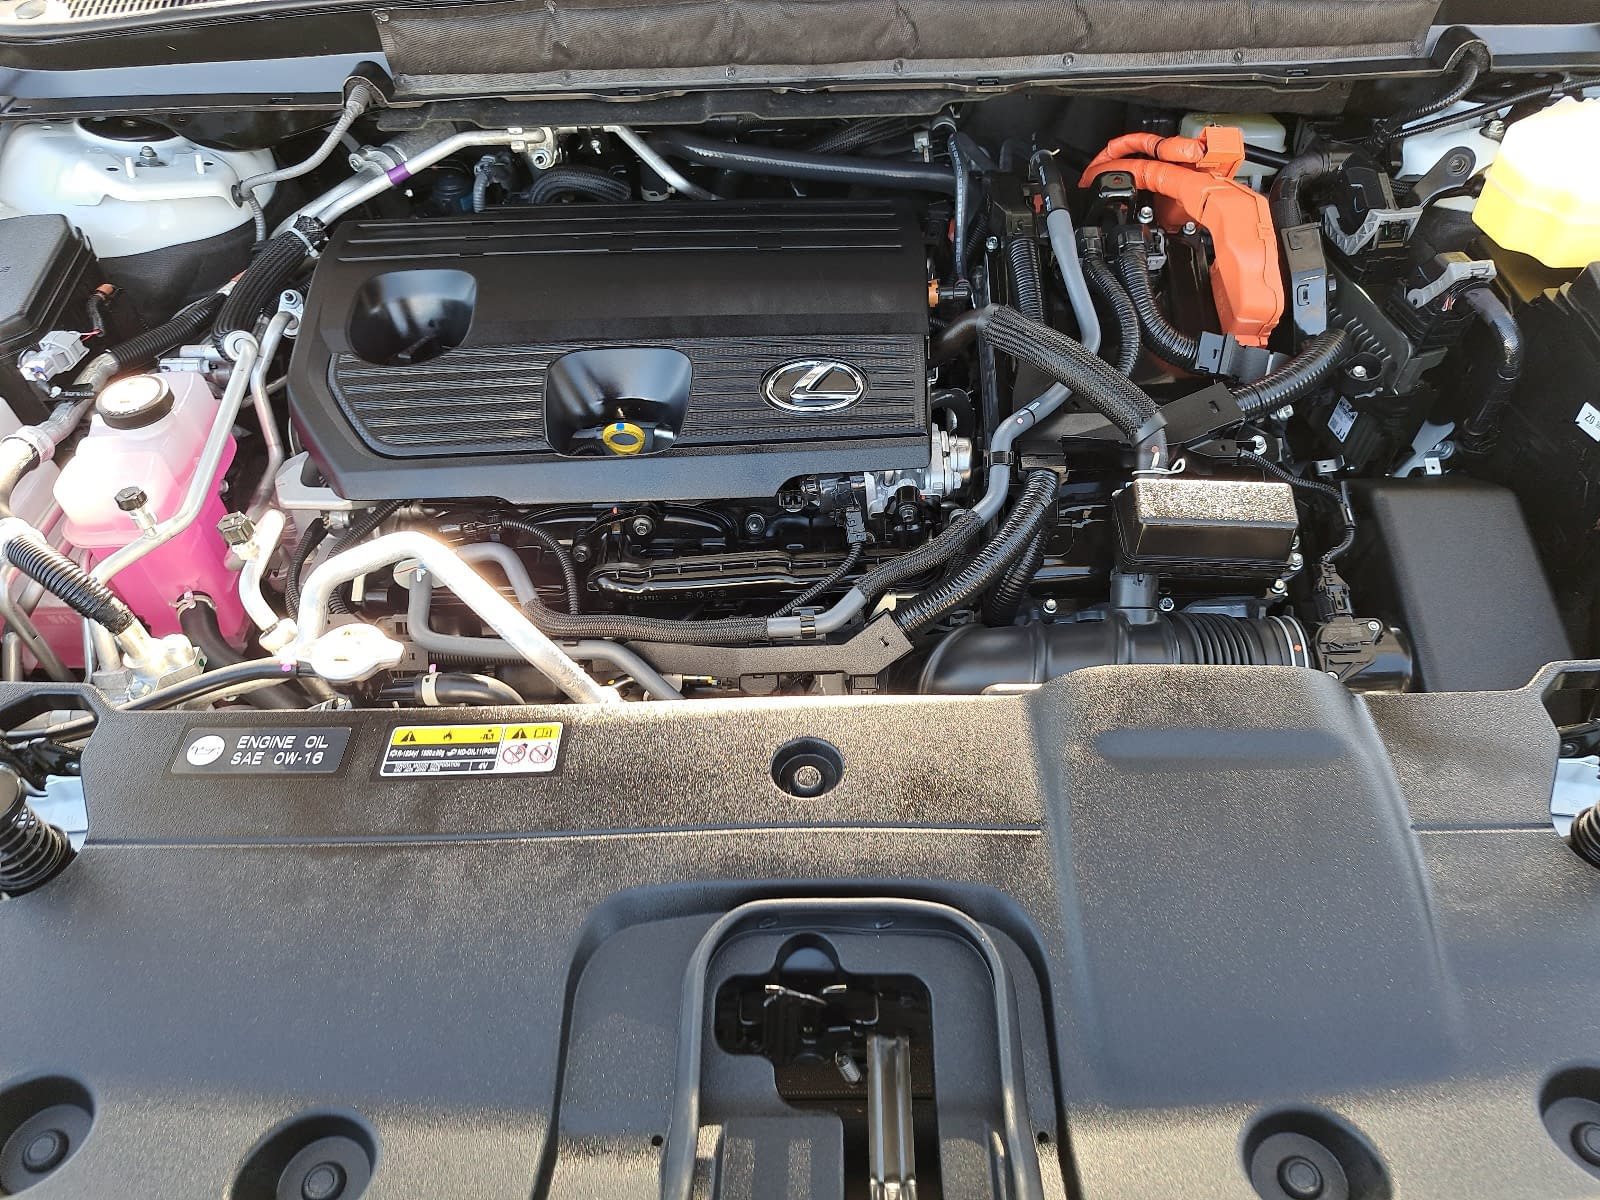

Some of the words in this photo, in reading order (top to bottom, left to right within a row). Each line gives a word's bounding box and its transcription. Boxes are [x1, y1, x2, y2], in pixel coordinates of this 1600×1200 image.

[236, 735, 296, 749] ENGINE
[305, 735, 329, 749] OIL
[230, 751, 265, 765] SAE
